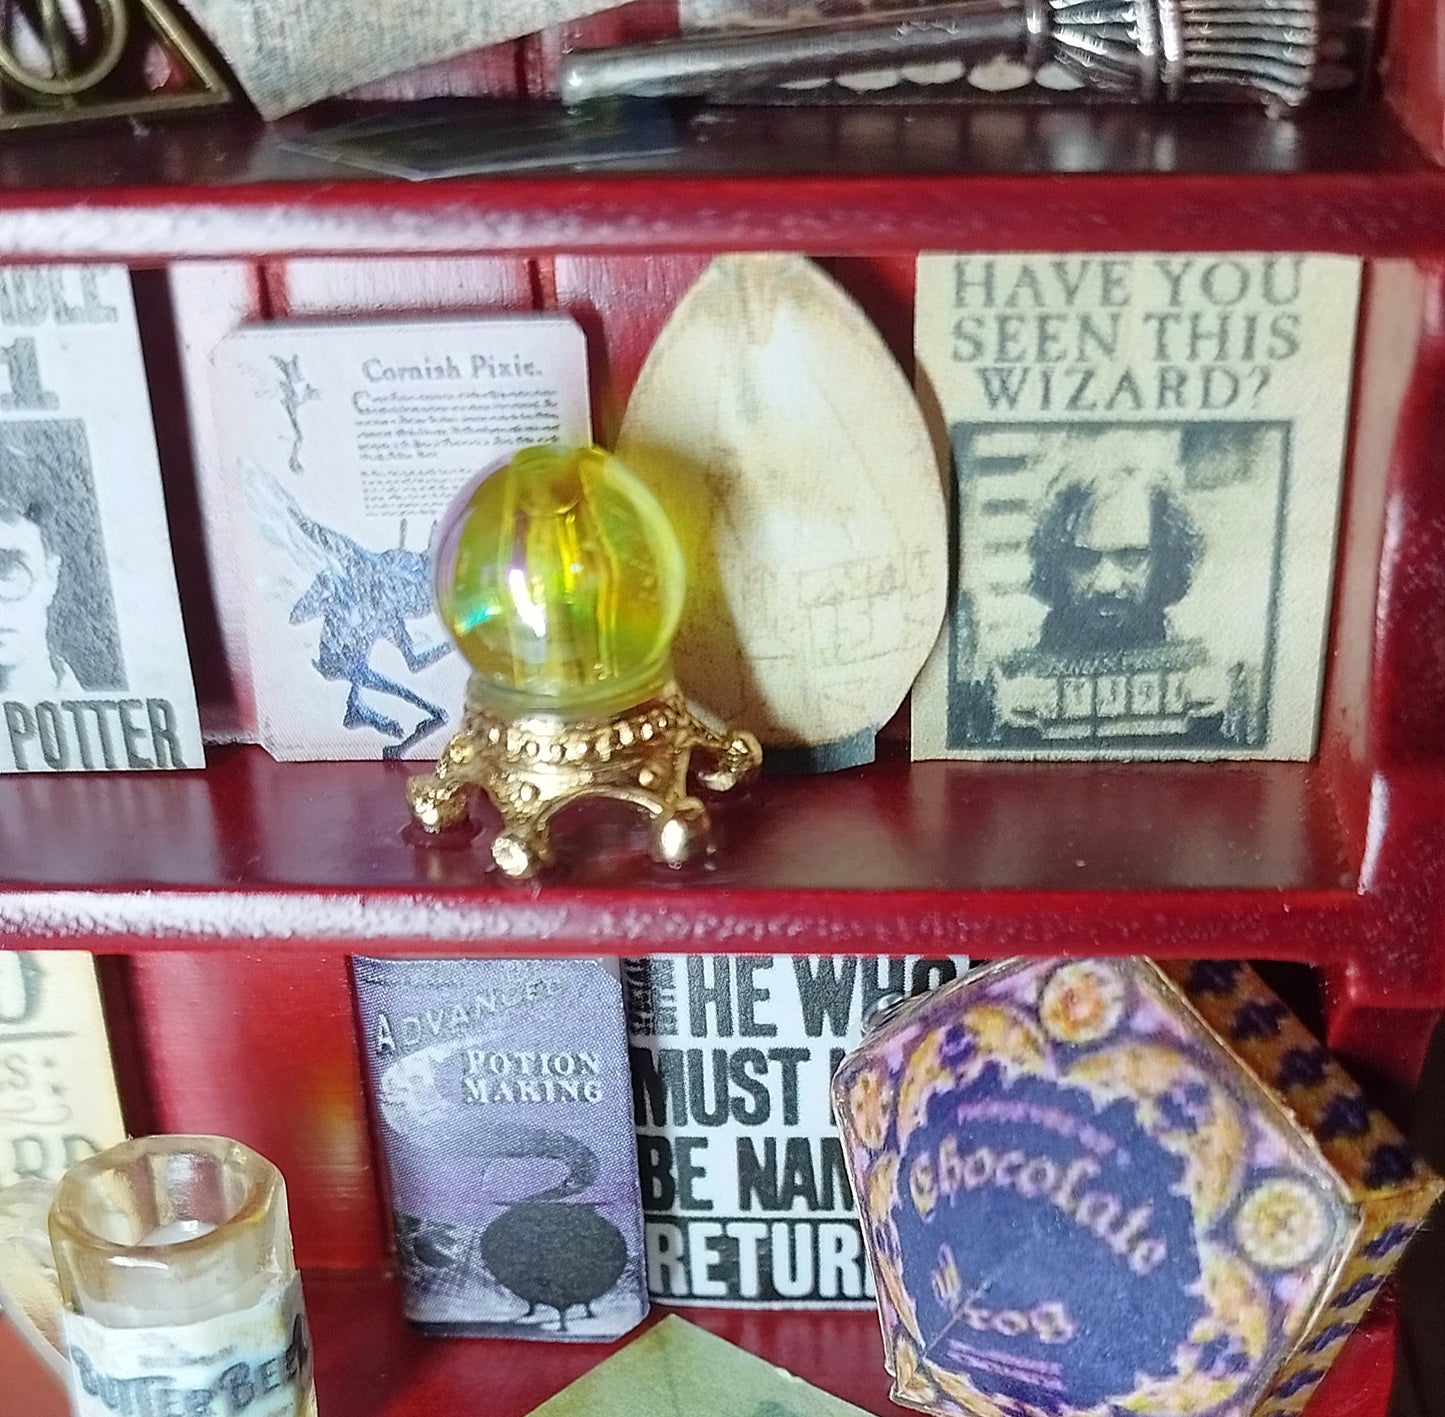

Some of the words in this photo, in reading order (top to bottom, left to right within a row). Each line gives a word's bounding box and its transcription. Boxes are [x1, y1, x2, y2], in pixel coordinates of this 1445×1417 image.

[952, 258, 1131, 308] HAVE
[1154, 256, 1304, 306] YOU
[951, 311, 1121, 364] SEEN
[1142, 311, 1301, 363] THIS
[361, 355, 462, 383] Cornish
[470, 353, 543, 379] Pixie.
[977, 364, 1272, 412] WIZARD?
[3, 698, 188, 771] POTTER
[687, 954, 778, 1038] HE
[464, 1050, 601, 1076] POTION
[631, 1047, 811, 1128] MUST
[464, 1077, 602, 1103] MAKING
[639, 1136, 714, 1213] BE
[736, 1136, 857, 1213] NAM
[648, 1221, 880, 1299] RETUR
